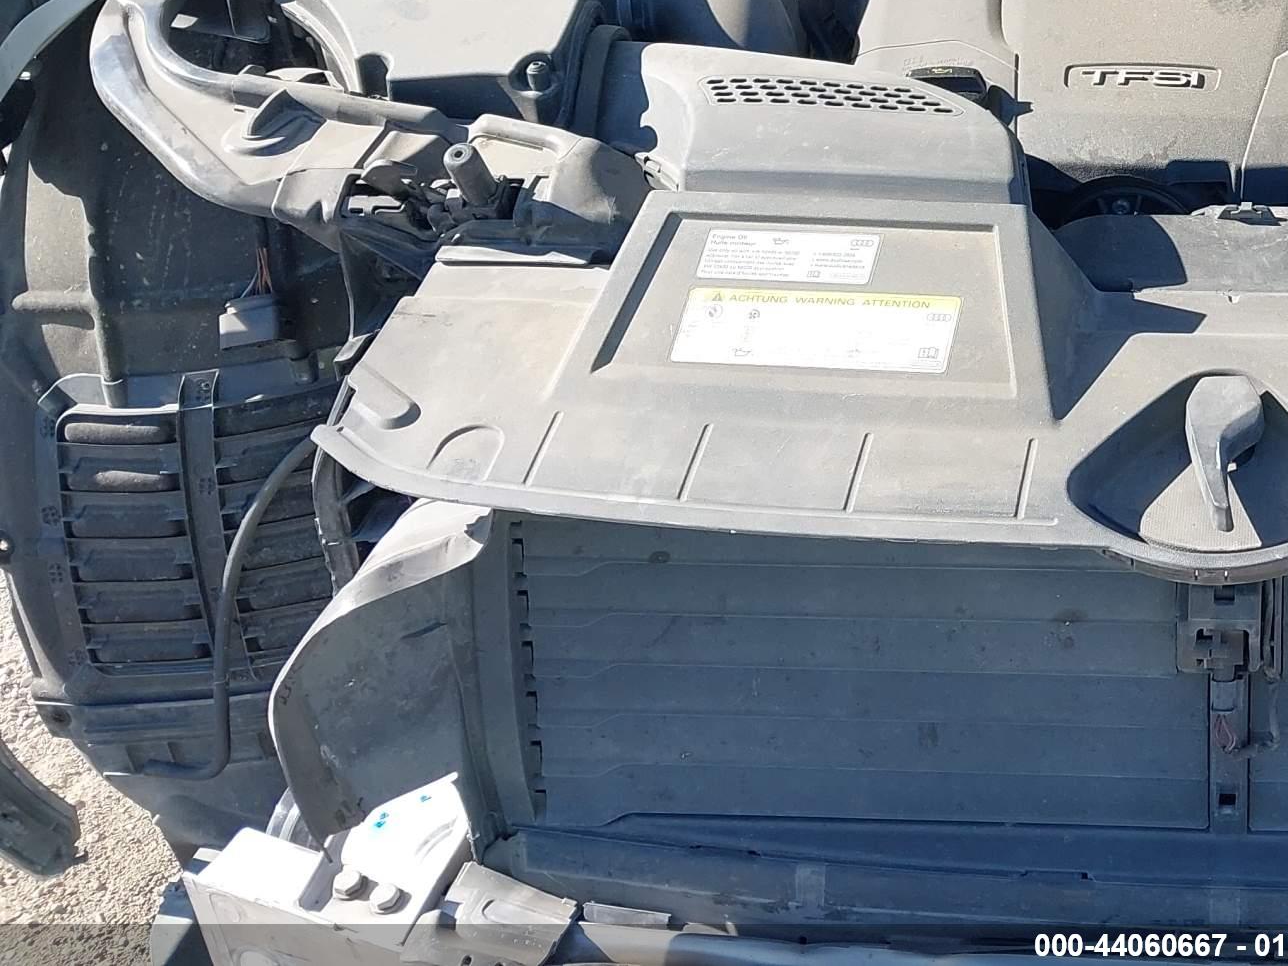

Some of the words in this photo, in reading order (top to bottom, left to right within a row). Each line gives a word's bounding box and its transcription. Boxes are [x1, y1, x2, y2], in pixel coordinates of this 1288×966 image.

[1081, 70, 1205, 88] TFSI
[729, 293, 788, 304] ACHTUNG
[795, 296, 855, 306] WARNING
[861, 298, 931, 309] ATTENTION
